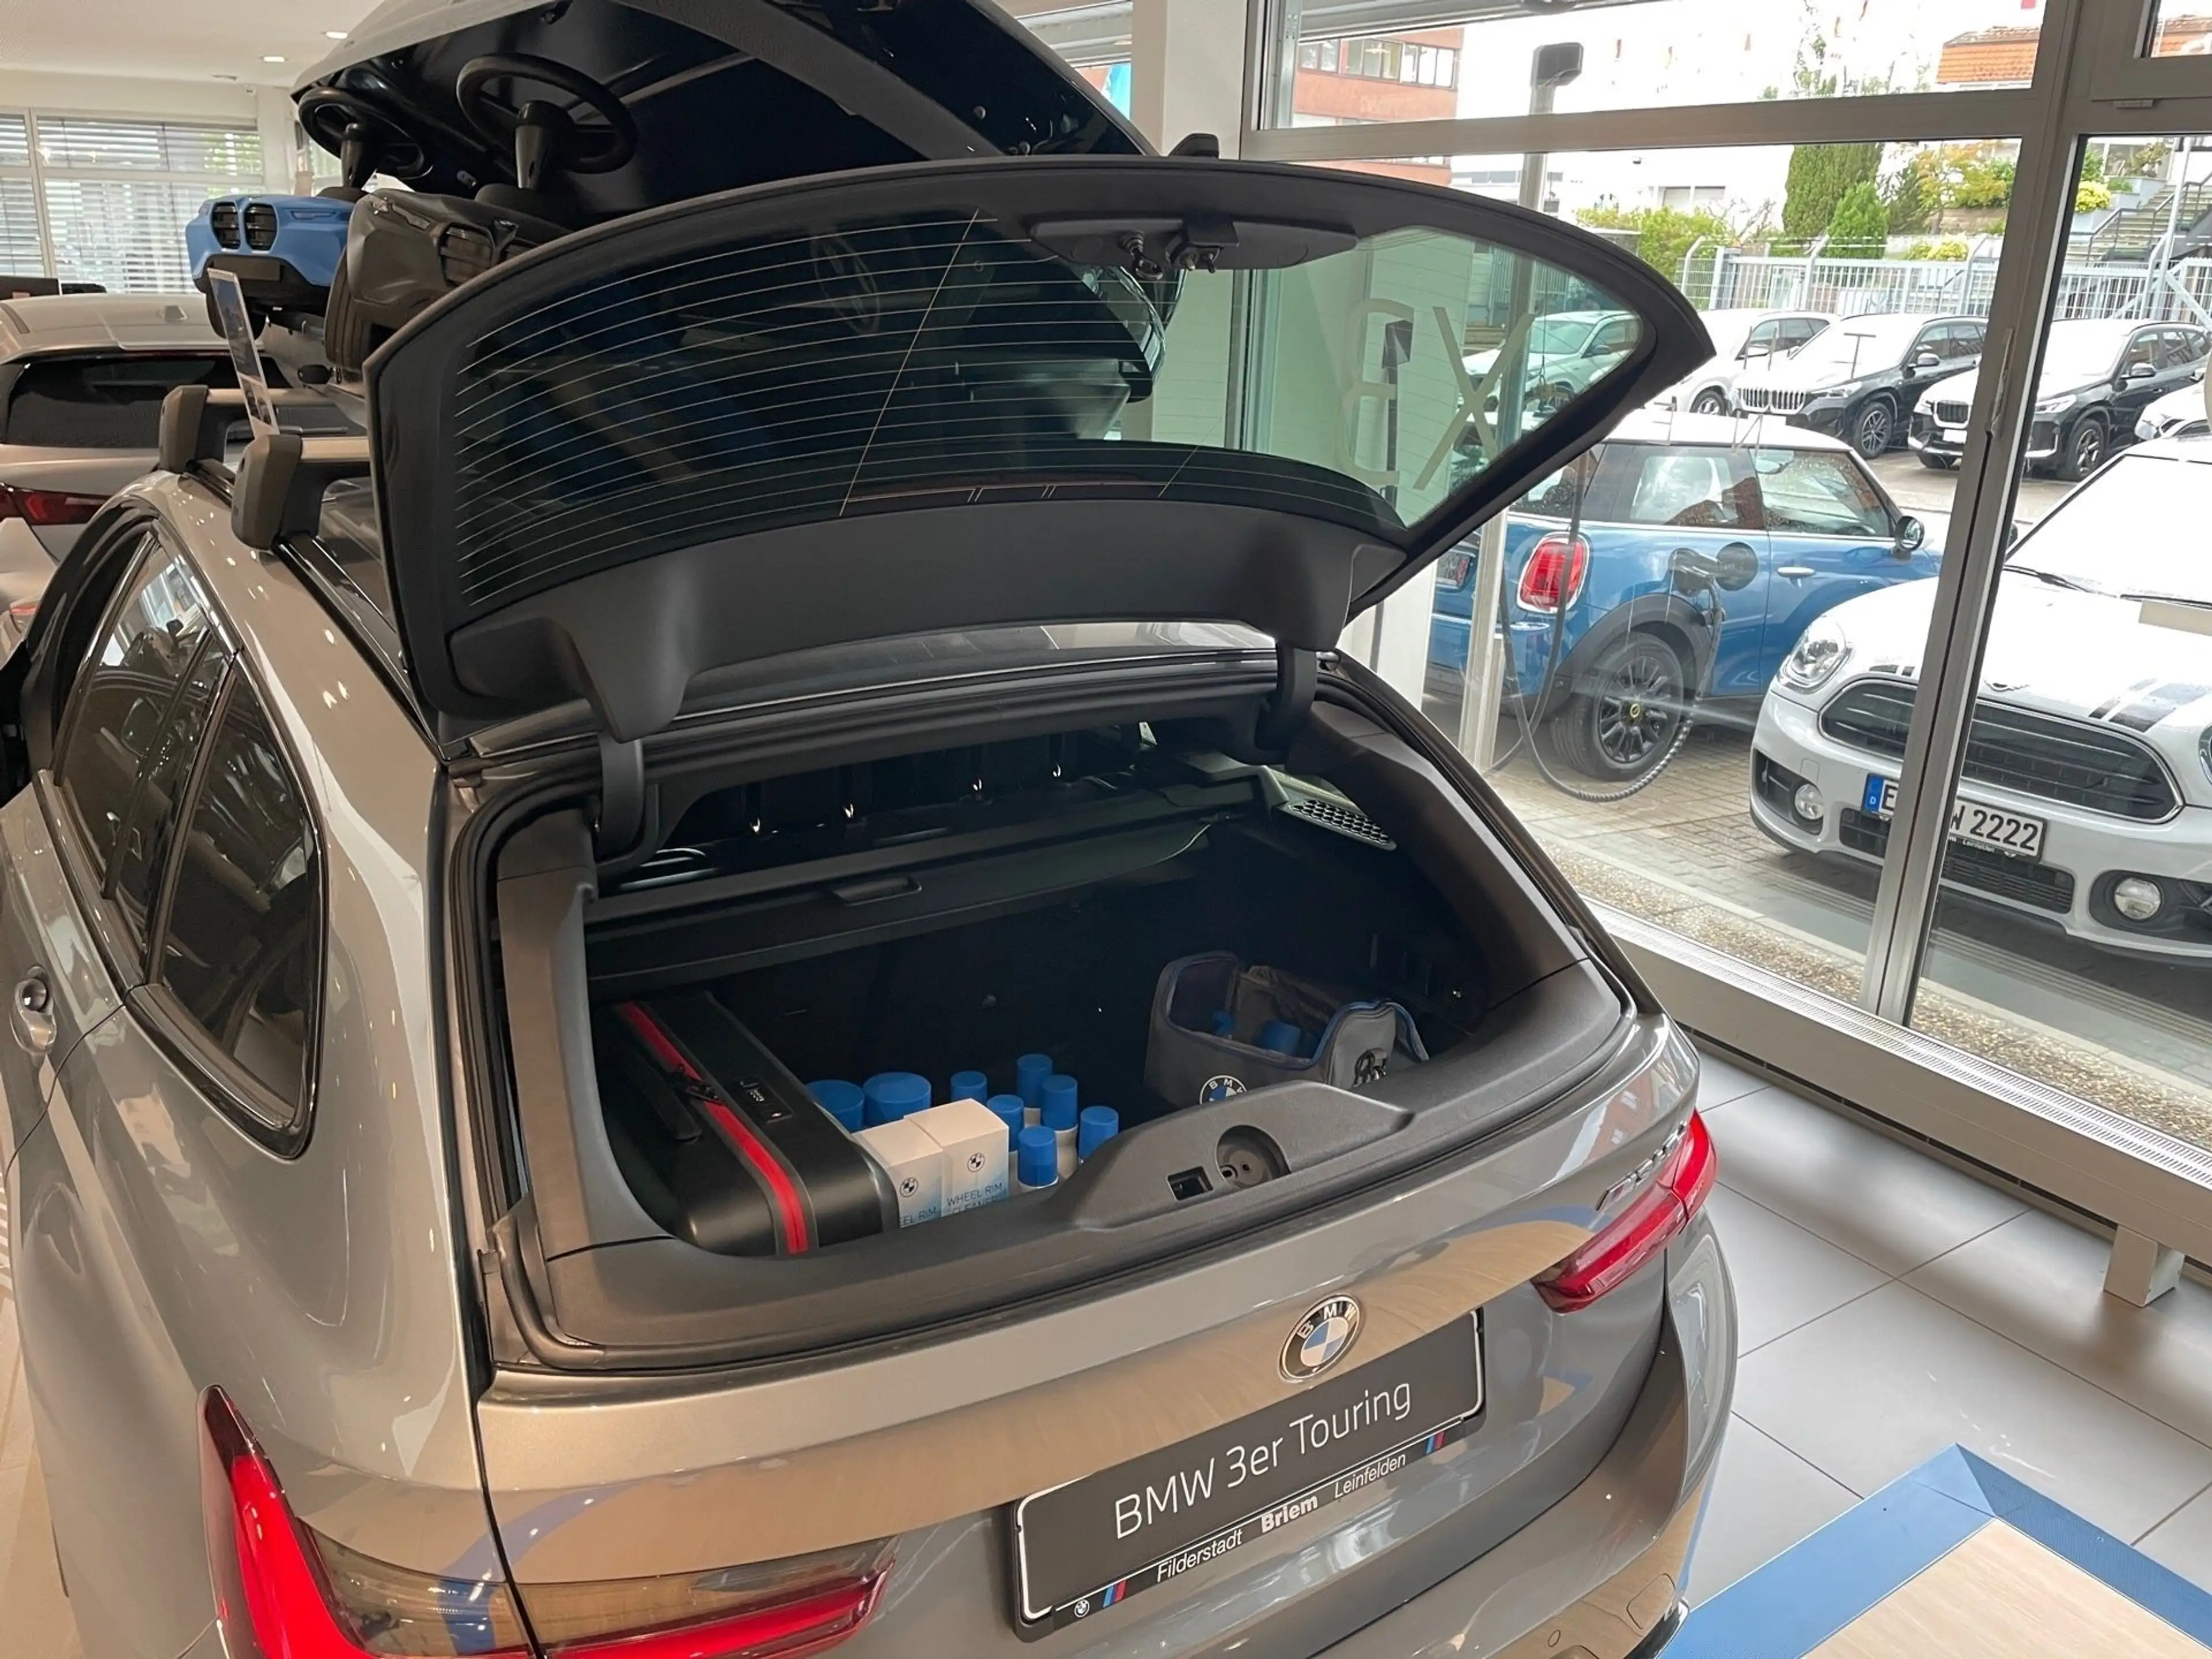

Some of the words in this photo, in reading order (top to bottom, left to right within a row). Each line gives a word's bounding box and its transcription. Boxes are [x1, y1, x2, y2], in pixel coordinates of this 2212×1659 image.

[1969, 809, 2038, 851] 2222
[919, 1206, 936, 1219] RIM
[947, 1189, 983, 1206] WHEEL
[985, 1183, 1002, 1195] RIM
[1297, 1303, 1357, 1338] BMW
[1115, 1457, 1215, 1539] BMW
[1226, 1437, 1283, 1488] 3er
[1289, 1382, 1410, 1455] Touring
[1157, 1529, 1243, 1582] Filderstadt
[1262, 1495, 1318, 1533] Briem
[1335, 1454, 1406, 1498] Leinfelden
